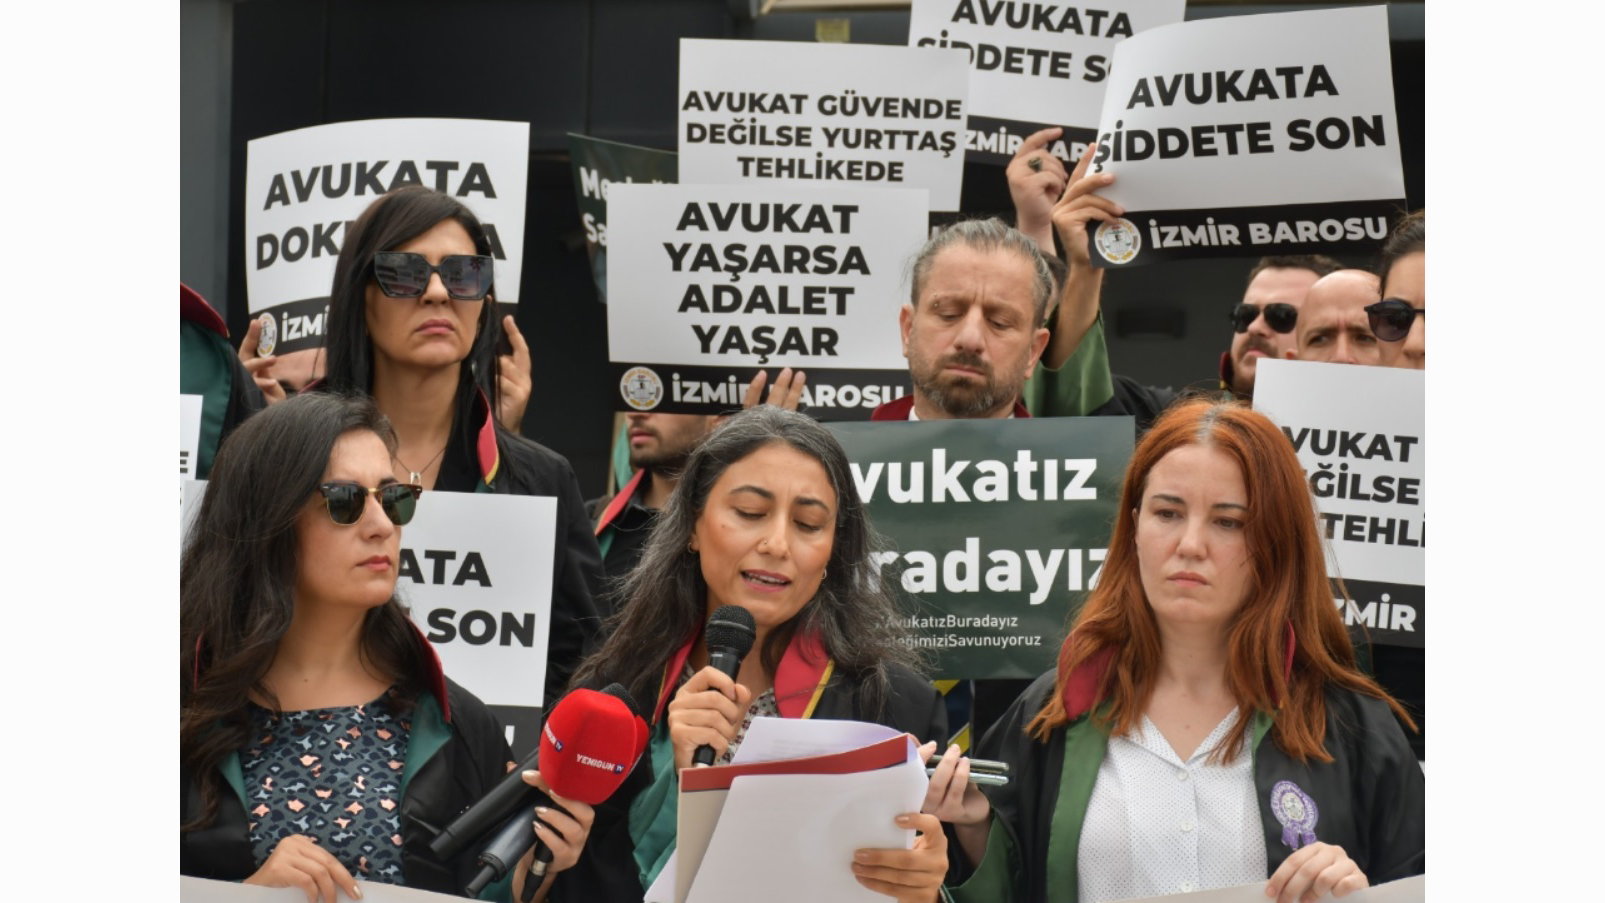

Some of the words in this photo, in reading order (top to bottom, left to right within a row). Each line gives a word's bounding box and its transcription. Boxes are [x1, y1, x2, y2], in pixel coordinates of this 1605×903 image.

[951, 0, 1134, 38] AVUKATA
[917, 29, 1072, 79] DETE
[682, 91, 808, 115] AVUKAT
[817, 90, 962, 120] GÜVENDE
[1126, 64, 1339, 110] AVUKATA
[686, 117, 812, 147] DEĞİLSE
[821, 127, 956, 158] YURTTAŞ
[965, 126, 1025, 156] ZMİR
[1093, 119, 1275, 173] ŞİDDETE
[1286, 114, 1386, 152] SON
[263, 160, 498, 211] AVUKATA
[737, 151, 904, 183] TEHLİKEDE
[676, 202, 859, 234] AVUKAT
[1149, 217, 1241, 249] İZMİR
[1248, 216, 1388, 245] BAROSU
[256, 220, 507, 271] DOKA
[662, 243, 871, 282] YAŞARSA
[677, 284, 855, 316] ADALET
[691, 325, 839, 365] YAŞAR
[769, 384, 904, 409] AROSU
[1281, 426, 1418, 463] VUKAT
[849, 448, 1097, 503] vukatız
[1304, 462, 1420, 506] ĞİLSE
[427, 607, 536, 648] SON
[1334, 593, 1416, 632] MİR
